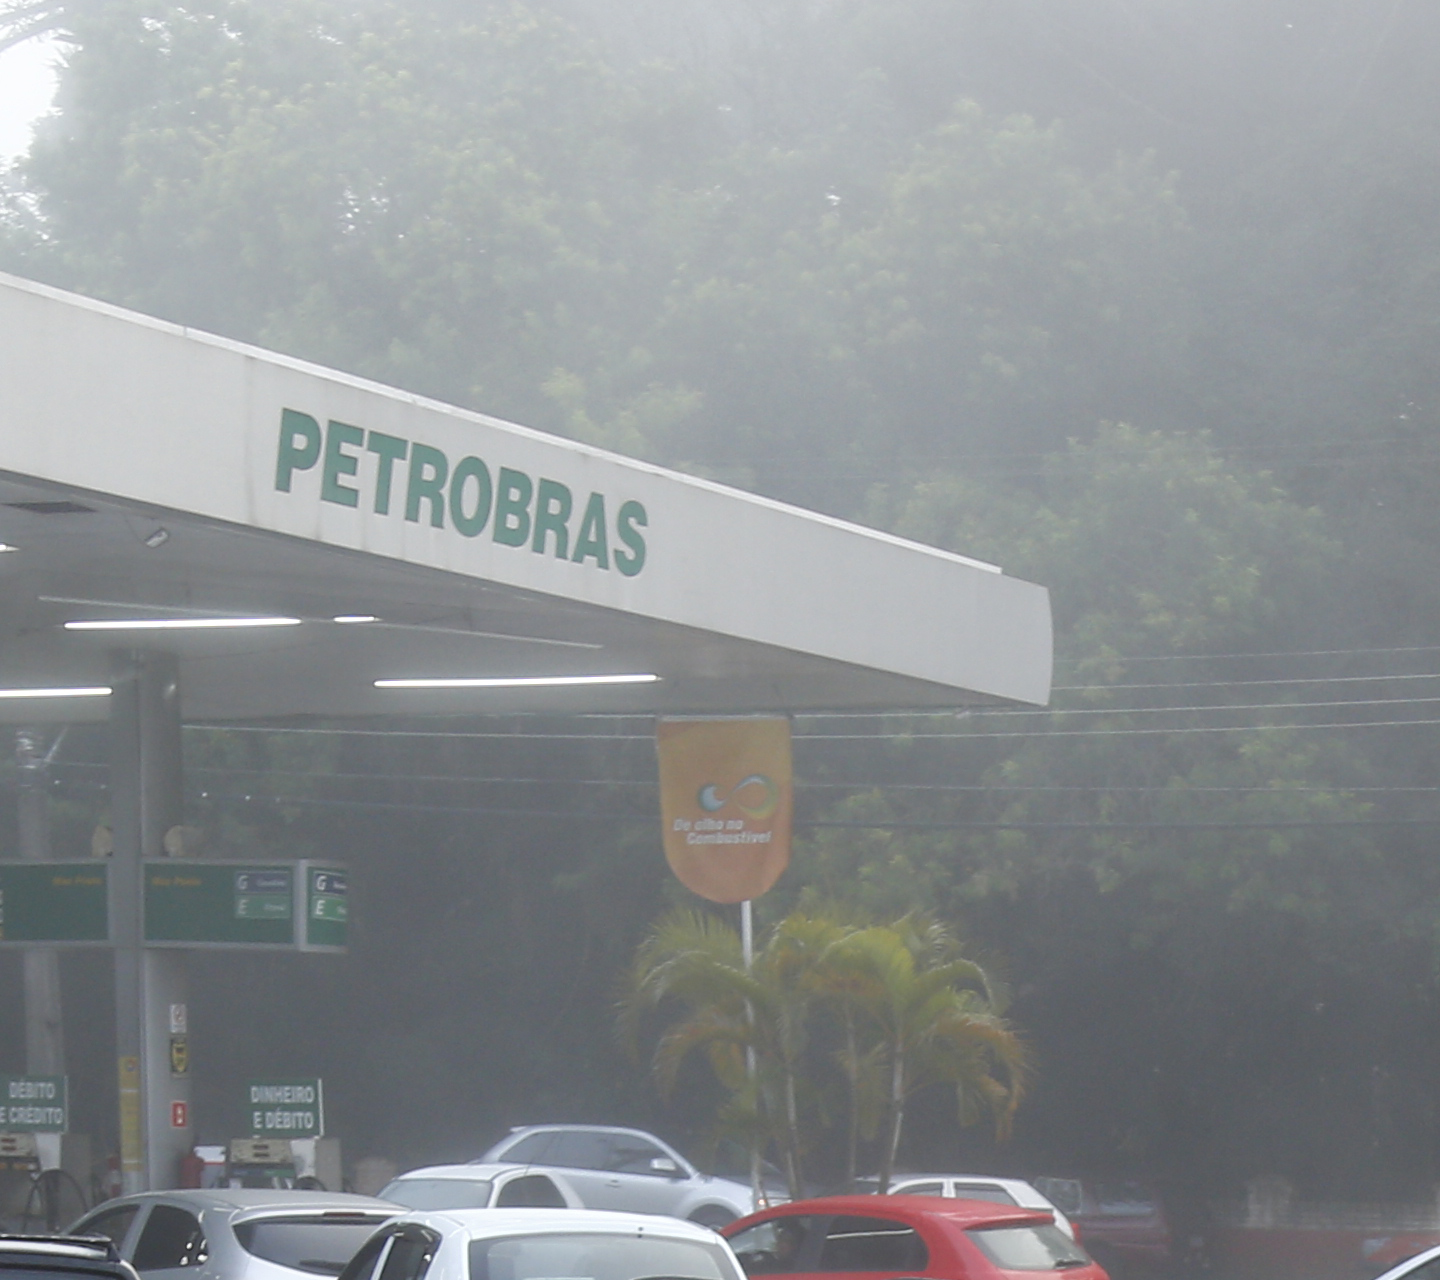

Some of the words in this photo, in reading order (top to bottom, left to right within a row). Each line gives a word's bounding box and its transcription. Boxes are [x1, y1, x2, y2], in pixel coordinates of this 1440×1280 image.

[275, 407, 648, 577] PETROBRAS
[9, 1080, 55, 1099] DÉBITO
[250, 1086, 314, 1103] DINHEIRO
[10, 1105, 64, 1124] CRÉDITO
[253, 1111, 262, 1128] E
[265, 1108, 314, 1129] DÉBITO
